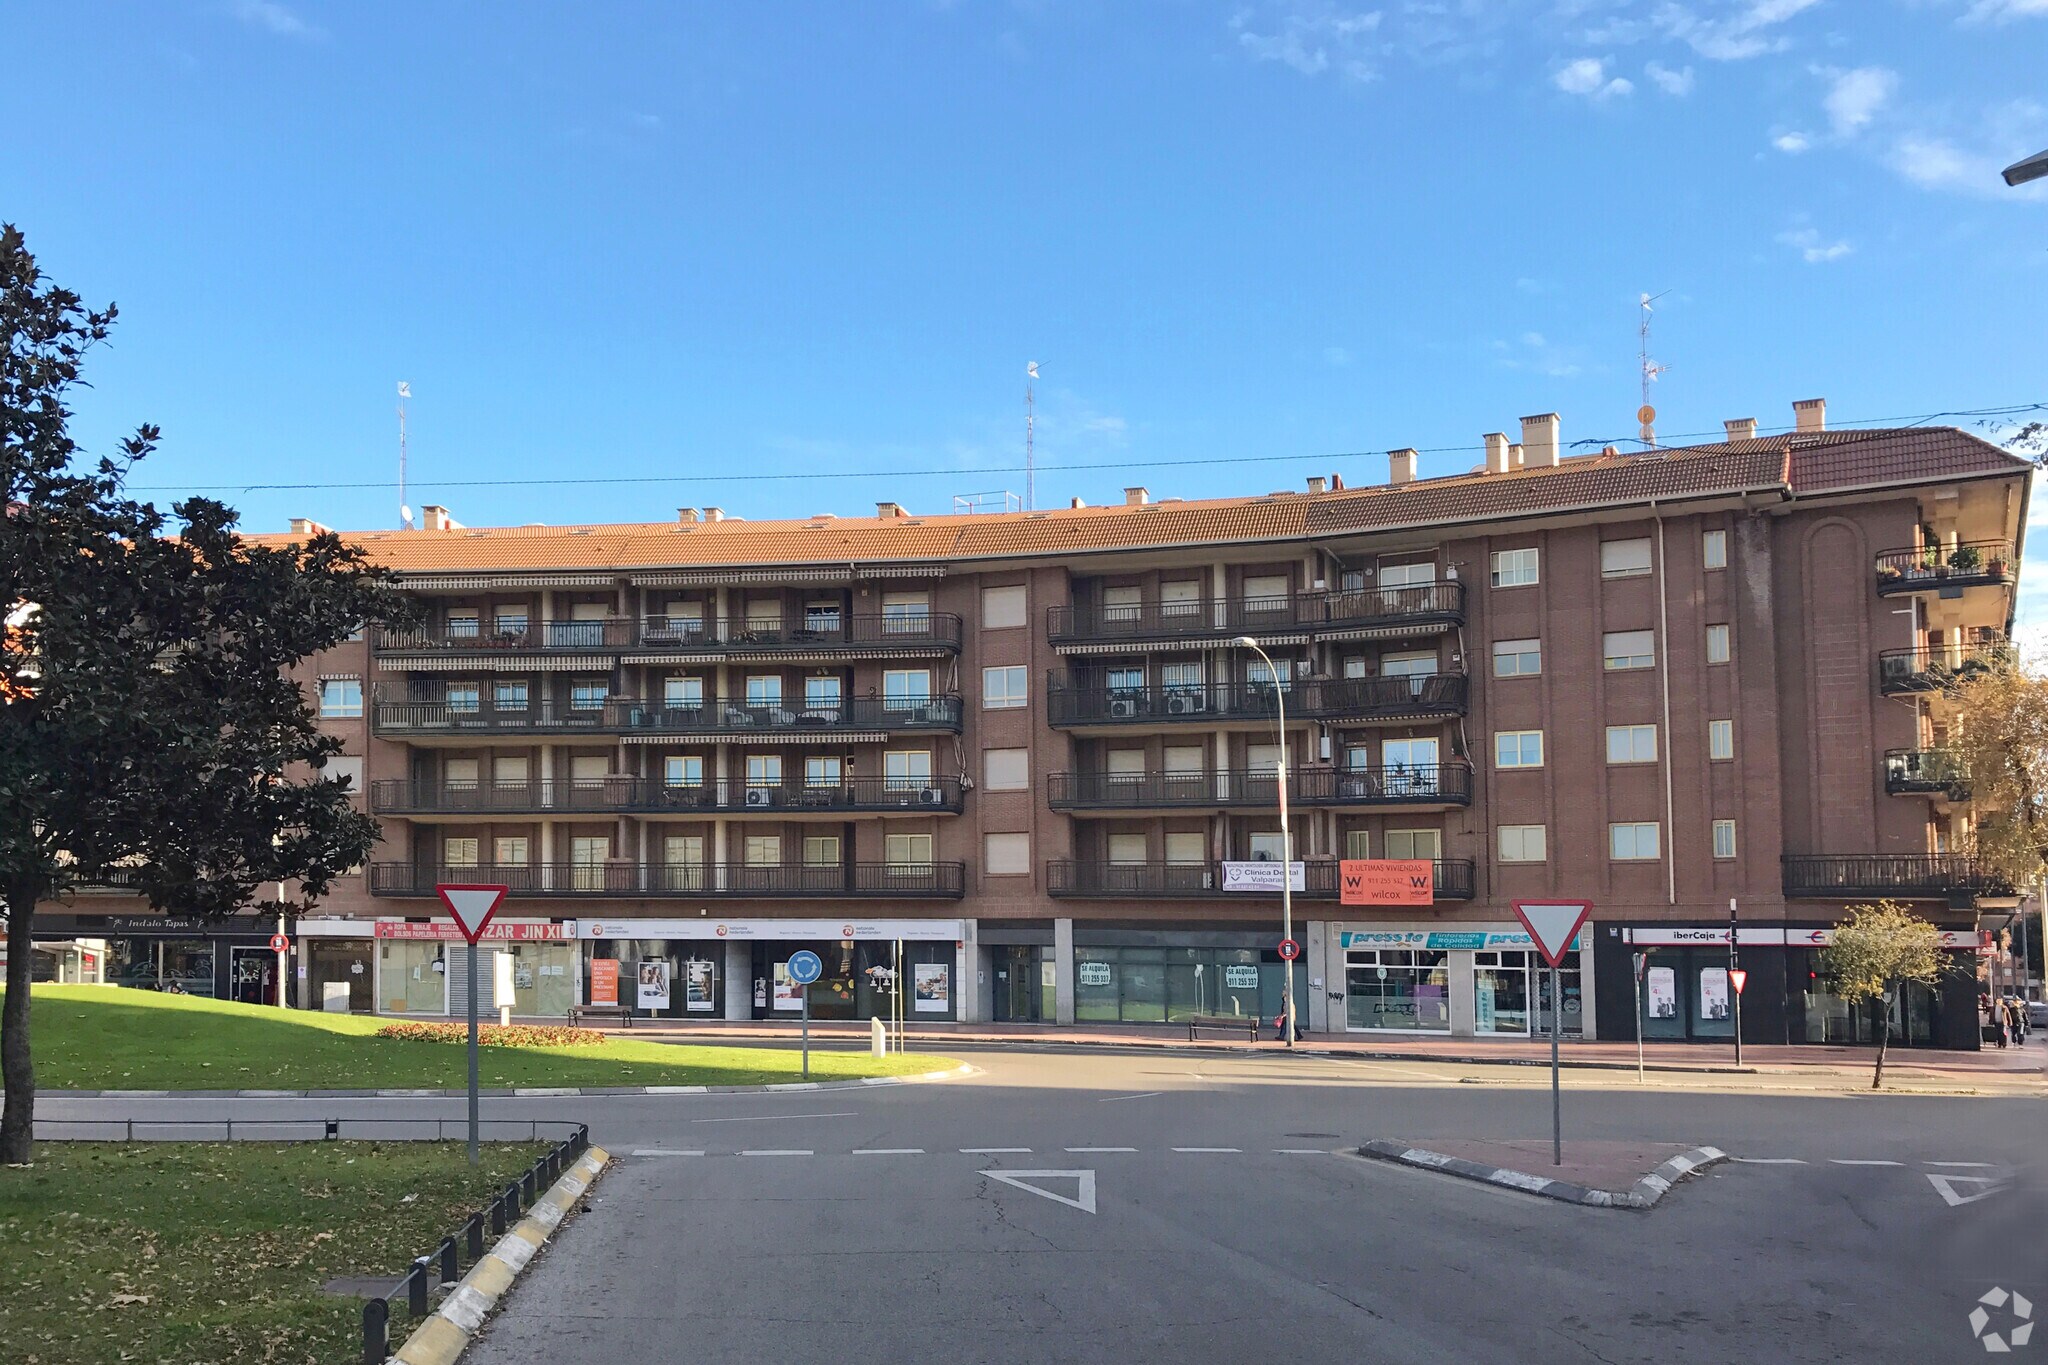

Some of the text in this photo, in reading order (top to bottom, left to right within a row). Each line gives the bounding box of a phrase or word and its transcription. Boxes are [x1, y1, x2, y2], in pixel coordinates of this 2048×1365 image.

[1346, 876, 1362, 888] W
[1410, 876, 1427, 888] W
[1371, 890, 1400, 898] wilcox
[128, 919, 188, 928] Indalo Tapas
[521, 925, 543, 938] JIN
[1674, 931, 1715, 940] iberCaja
[1489, 933, 1533, 944] pres
